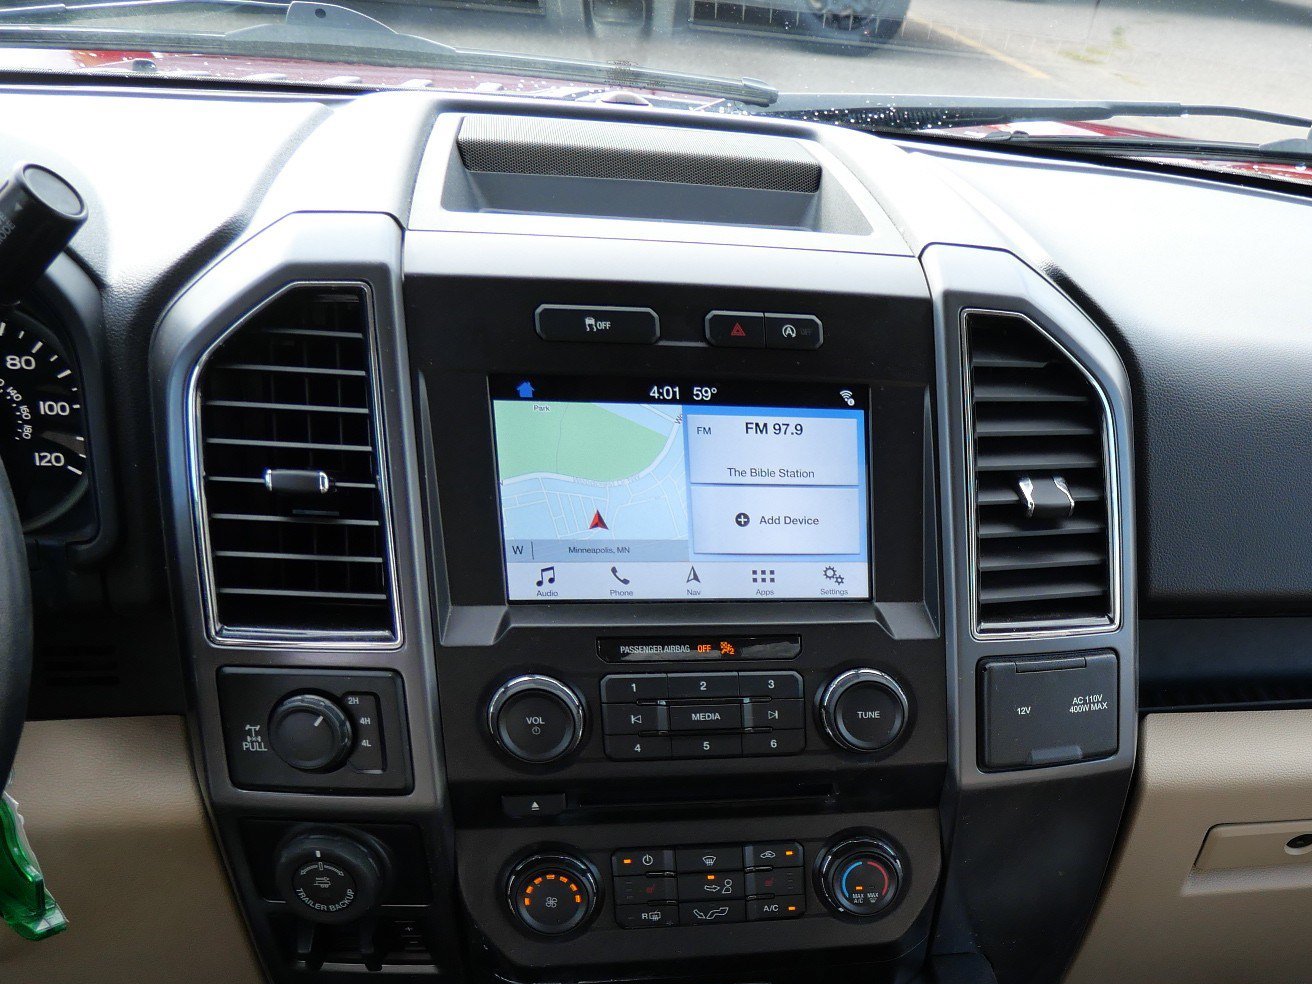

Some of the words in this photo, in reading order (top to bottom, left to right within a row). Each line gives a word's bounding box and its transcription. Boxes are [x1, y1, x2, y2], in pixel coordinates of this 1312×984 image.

[596, 320, 611, 330] OFF
[5, 355, 36, 370] 80
[6, 386, 22, 402] 140
[649, 385, 681, 400] 4:01
[693, 386, 718, 401] 59°
[19, 405, 31, 420] 160
[39, 401, 70, 416] 100
[533, 404, 550, 413] Park
[22, 424, 32, 440] 180
[696, 426, 712, 435] FM
[745, 421, 769, 435] FM
[772, 422, 804, 436] 97.9
[34, 452, 65, 467] 120
[727, 467, 748, 478] The
[750, 467, 776, 478] Bible
[778, 468, 815, 479] Station
[759, 515, 781, 526] Add
[783, 515, 820, 526] Device
[511, 545, 524, 555] W
[568, 546, 615, 556] Minneapolis,
[617, 546, 631, 554] MN
[536, 588, 559, 597] Audio
[609, 588, 634, 597] Phone
[686, 588, 702, 596] Nav
[755, 587, 775, 597] Apps
[819, 587, 849, 597] Settings
[619, 644, 663, 655] PASSENGER
[664, 644, 690, 654] AIRBAG
[697, 644, 712, 653] OFF
[631, 683, 637, 692] 1
[699, 681, 707, 690] 2
[767, 679, 775, 689] 3
[347, 696, 360, 705] 2H
[1072, 696, 1084, 704] AC
[1085, 694, 1103, 703] 110V
[1016, 706, 1031, 715] 12V
[1069, 703, 1089, 714] 400W
[1090, 701, 1108, 711] MAX
[691, 711, 721, 722] MEDIA
[856, 710, 881, 719] TUNE
[359, 717, 371, 725] 4H
[526, 716, 545, 725] VOL
[242, 741, 268, 751] PULL
[361, 739, 372, 747] 4L
[634, 743, 642, 753] 4
[703, 741, 710, 750] 5
[770, 739, 778, 748] 6
[296, 887, 328, 911] TRAILER
[328, 888, 355, 912] BACKUP
[763, 904, 779, 913] A/C
